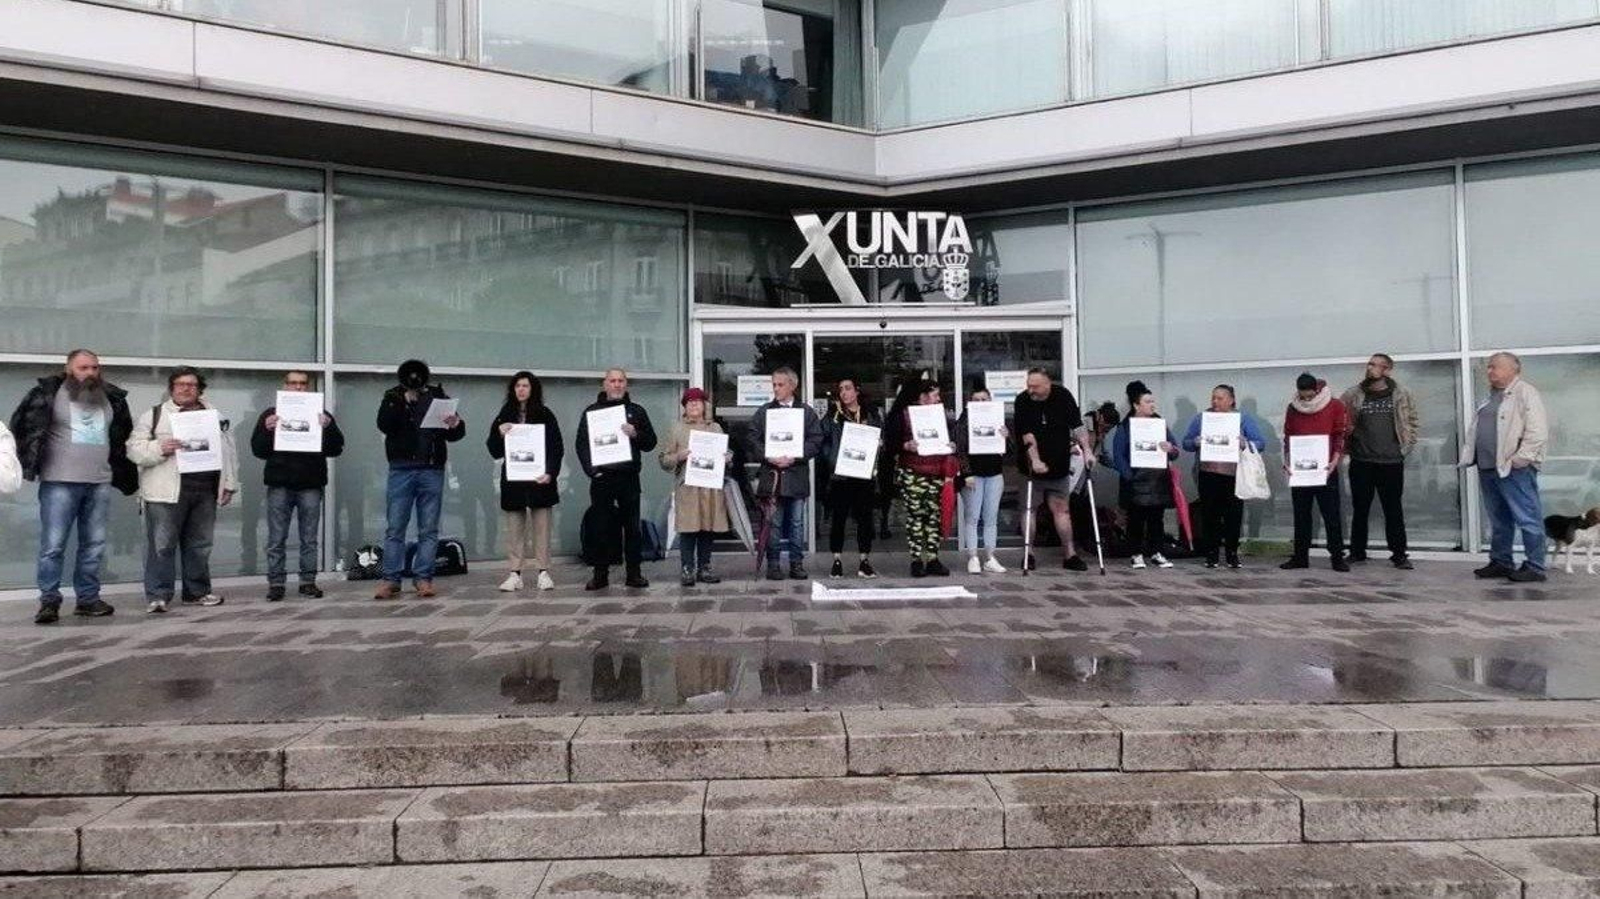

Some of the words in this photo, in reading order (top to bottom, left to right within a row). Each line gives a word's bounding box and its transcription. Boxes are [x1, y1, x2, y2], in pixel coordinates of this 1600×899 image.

[790, 210, 973, 305] XUNTA
[847, 254, 872, 269] DE
[874, 253, 940, 269] GALICIA
